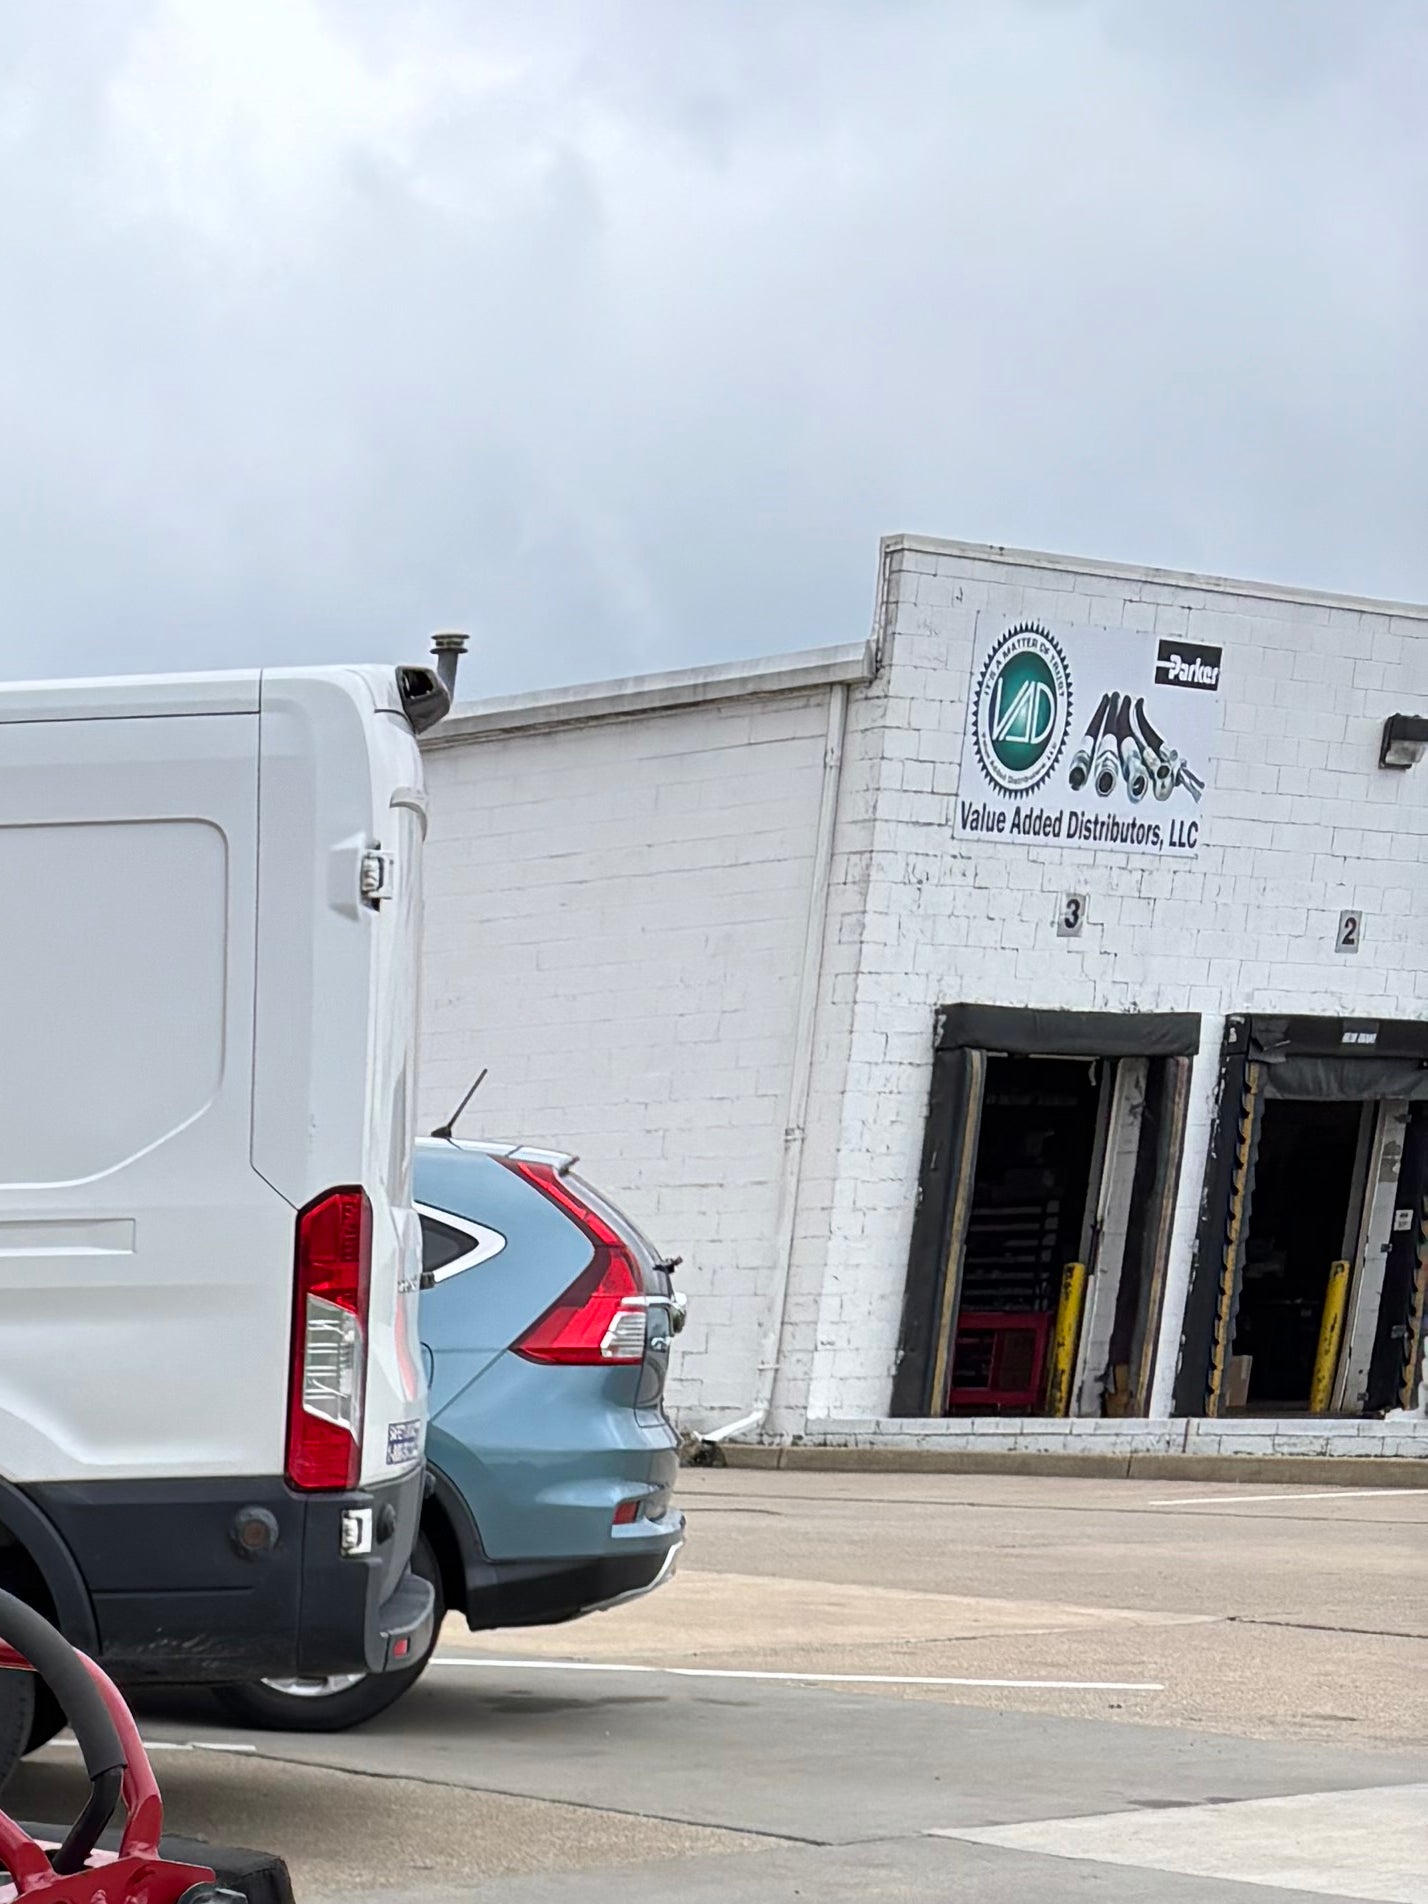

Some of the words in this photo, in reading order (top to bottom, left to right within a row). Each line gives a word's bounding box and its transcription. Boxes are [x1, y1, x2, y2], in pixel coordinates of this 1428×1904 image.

[1002, 637, 1038, 661] MATTER
[1168, 654, 1219, 685] Parker
[961, 801, 1006, 833] Value
[1010, 806, 1063, 838] Added
[1066, 811, 1163, 851] Distributors,
[1169, 818, 1199, 849] LLC
[1064, 899, 1081, 929] 3
[1341, 916, 1357, 945] 2
